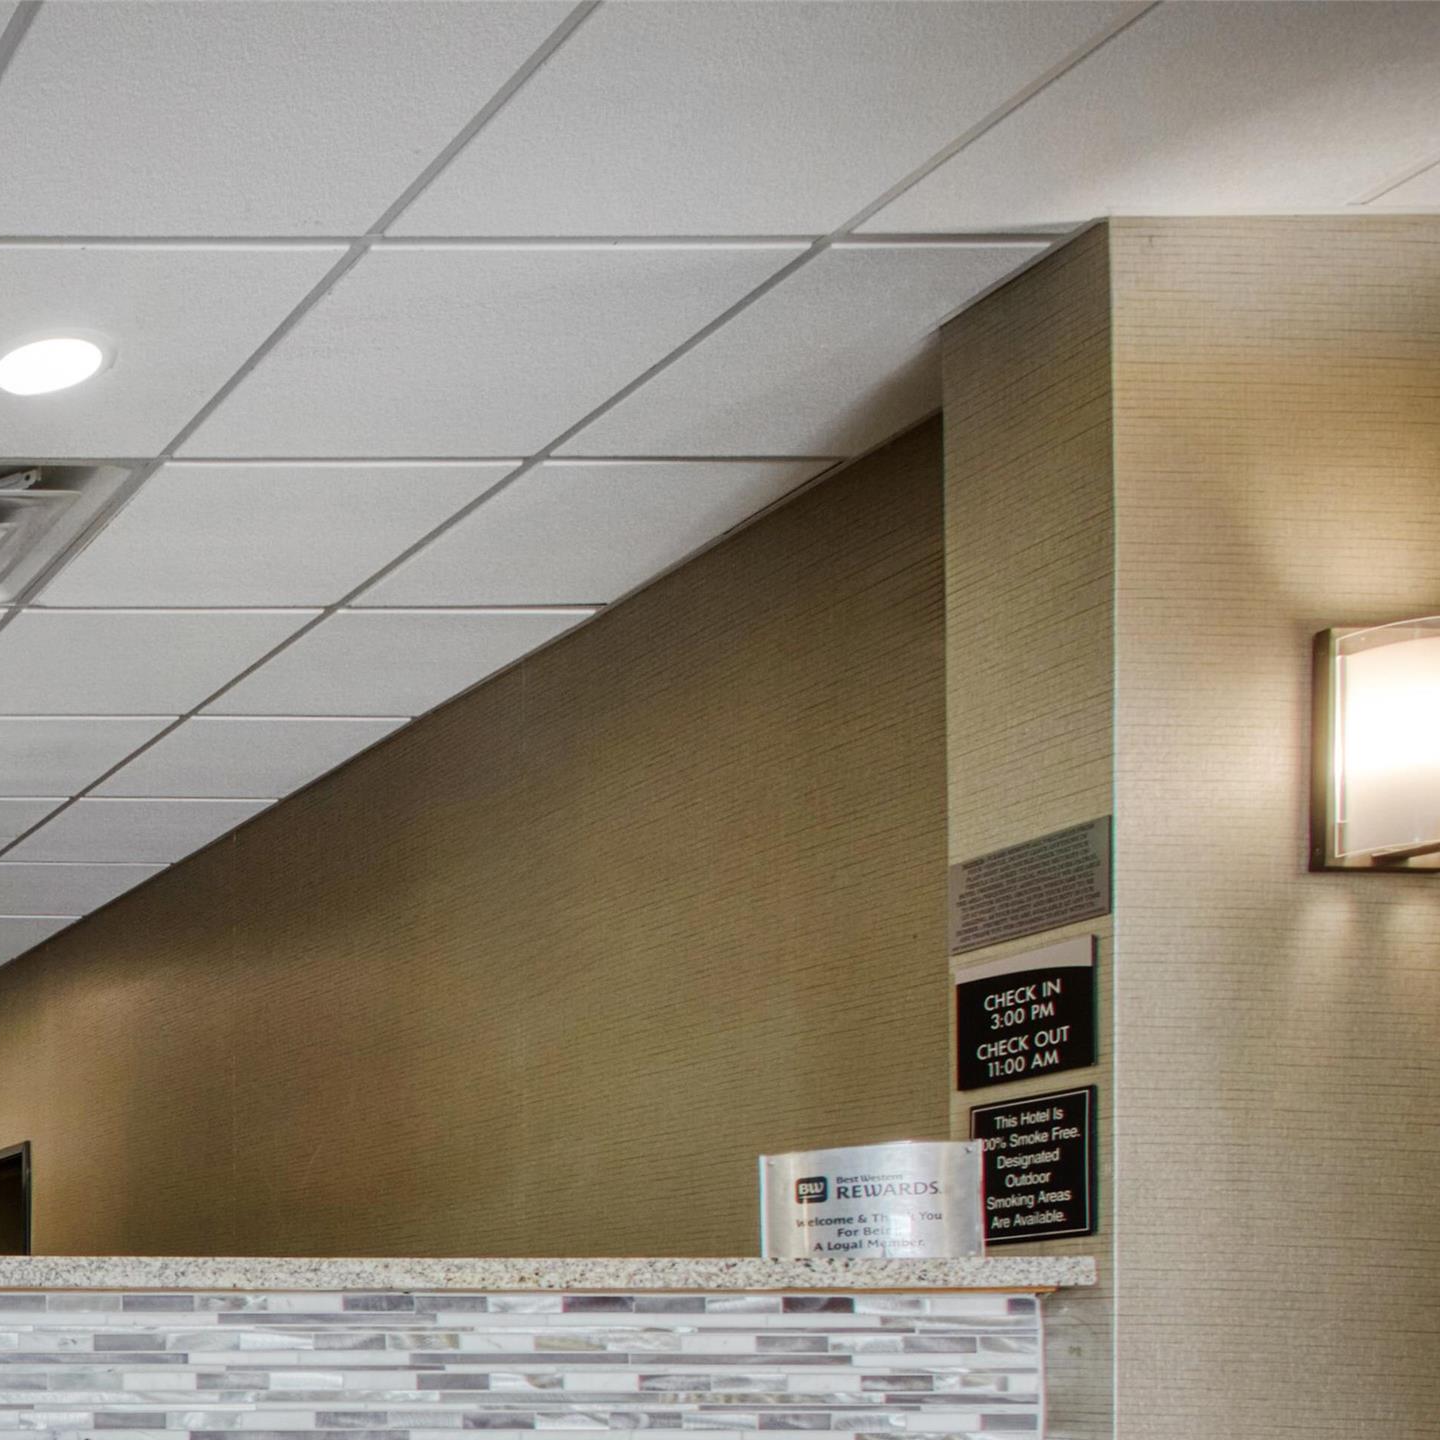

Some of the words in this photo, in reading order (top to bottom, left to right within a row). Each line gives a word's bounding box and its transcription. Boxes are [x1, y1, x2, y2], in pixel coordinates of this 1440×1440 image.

[984, 985, 1037, 1011] CHECK
[1042, 978, 1061, 998] IN
[990, 1008, 1025, 1030] 3:00
[1031, 1001, 1055, 1020] PM
[977, 1035, 1029, 1060] CHECK
[1034, 1025, 1070, 1048] OUT
[988, 1056, 1025, 1078] 11:00
[1031, 1049, 1059, 1070] AM
[994, 1115, 1018, 1130] This
[1020, 1108, 1050, 1126] Hotel
[1053, 1107, 1064, 1120] Is
[982, 1137, 1007, 1152] 00%
[1009, 1130, 1049, 1148] Smoke
[1051, 1127, 1080, 1141] Free.
[997, 1147, 1061, 1169] Designated
[798, 1181, 824, 1195] BW
[836, 1176, 859, 1184] Best
[860, 1174, 904, 1183] Western
[1005, 1172, 1052, 1188] Outdoor
[986, 1193, 1035, 1210] Smoking
[1038, 1189, 1072, 1204] Areas
[857, 1214, 867, 1223] &
[920, 1211, 943, 1221] You
[991, 1216, 1010, 1229] Are
[1013, 1209, 1067, 1227] Available.
[837, 1228, 859, 1237] For
[813, 1242, 823, 1251] A
[827, 1240, 863, 1252] Loyal
